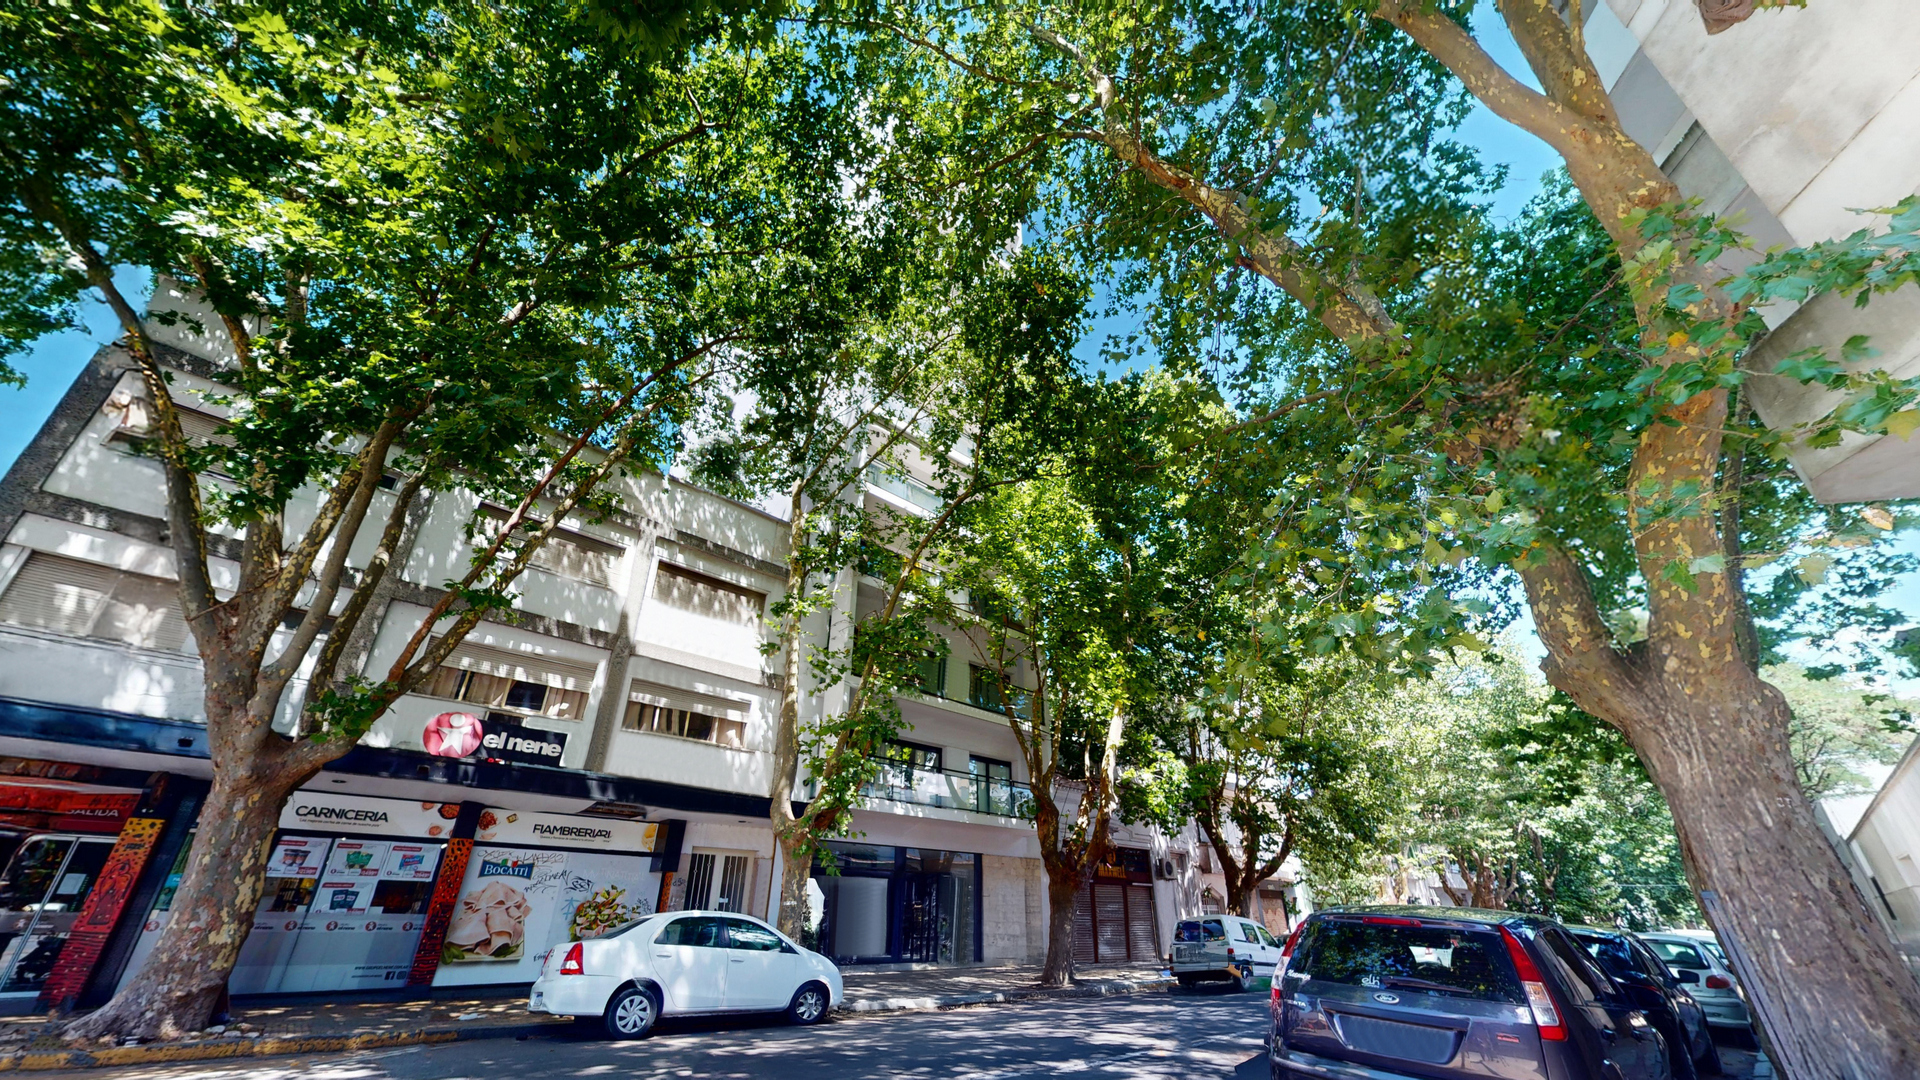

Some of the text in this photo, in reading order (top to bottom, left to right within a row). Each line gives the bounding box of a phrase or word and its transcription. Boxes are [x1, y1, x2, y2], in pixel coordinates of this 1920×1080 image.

[483, 732, 561, 757] el nene
[295, 805, 388, 822] CARNICERIA
